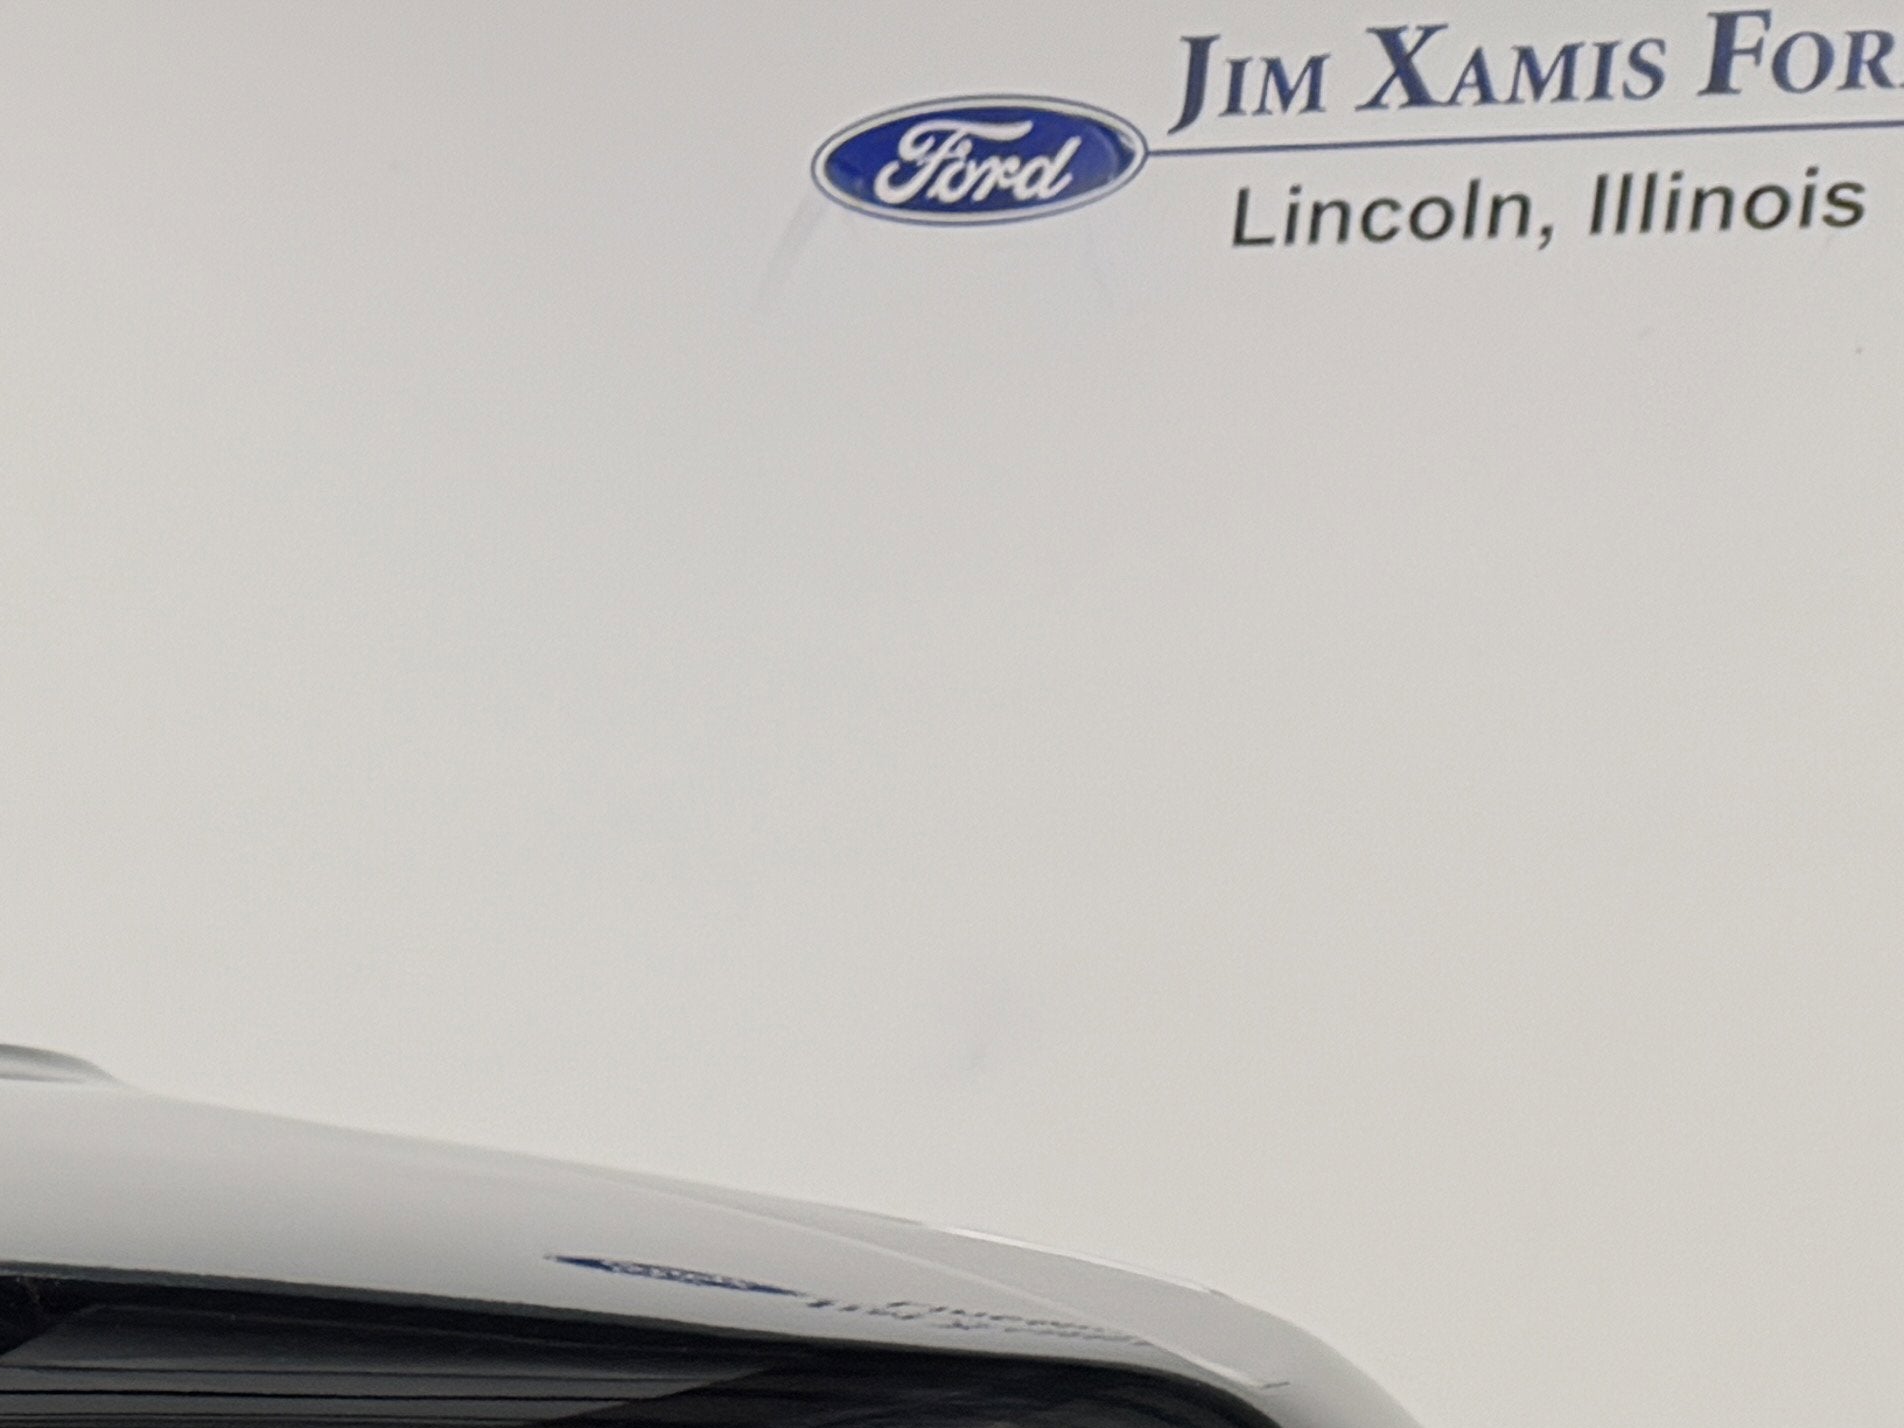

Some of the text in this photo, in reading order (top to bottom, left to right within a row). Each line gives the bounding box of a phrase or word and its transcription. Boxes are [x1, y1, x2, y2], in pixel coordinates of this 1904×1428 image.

[1166, 9, 1904, 135] JIM XAMIS FOR
[872, 118, 1082, 204] Ford
[1231, 166, 1866, 250] Lincoln, Illinois
